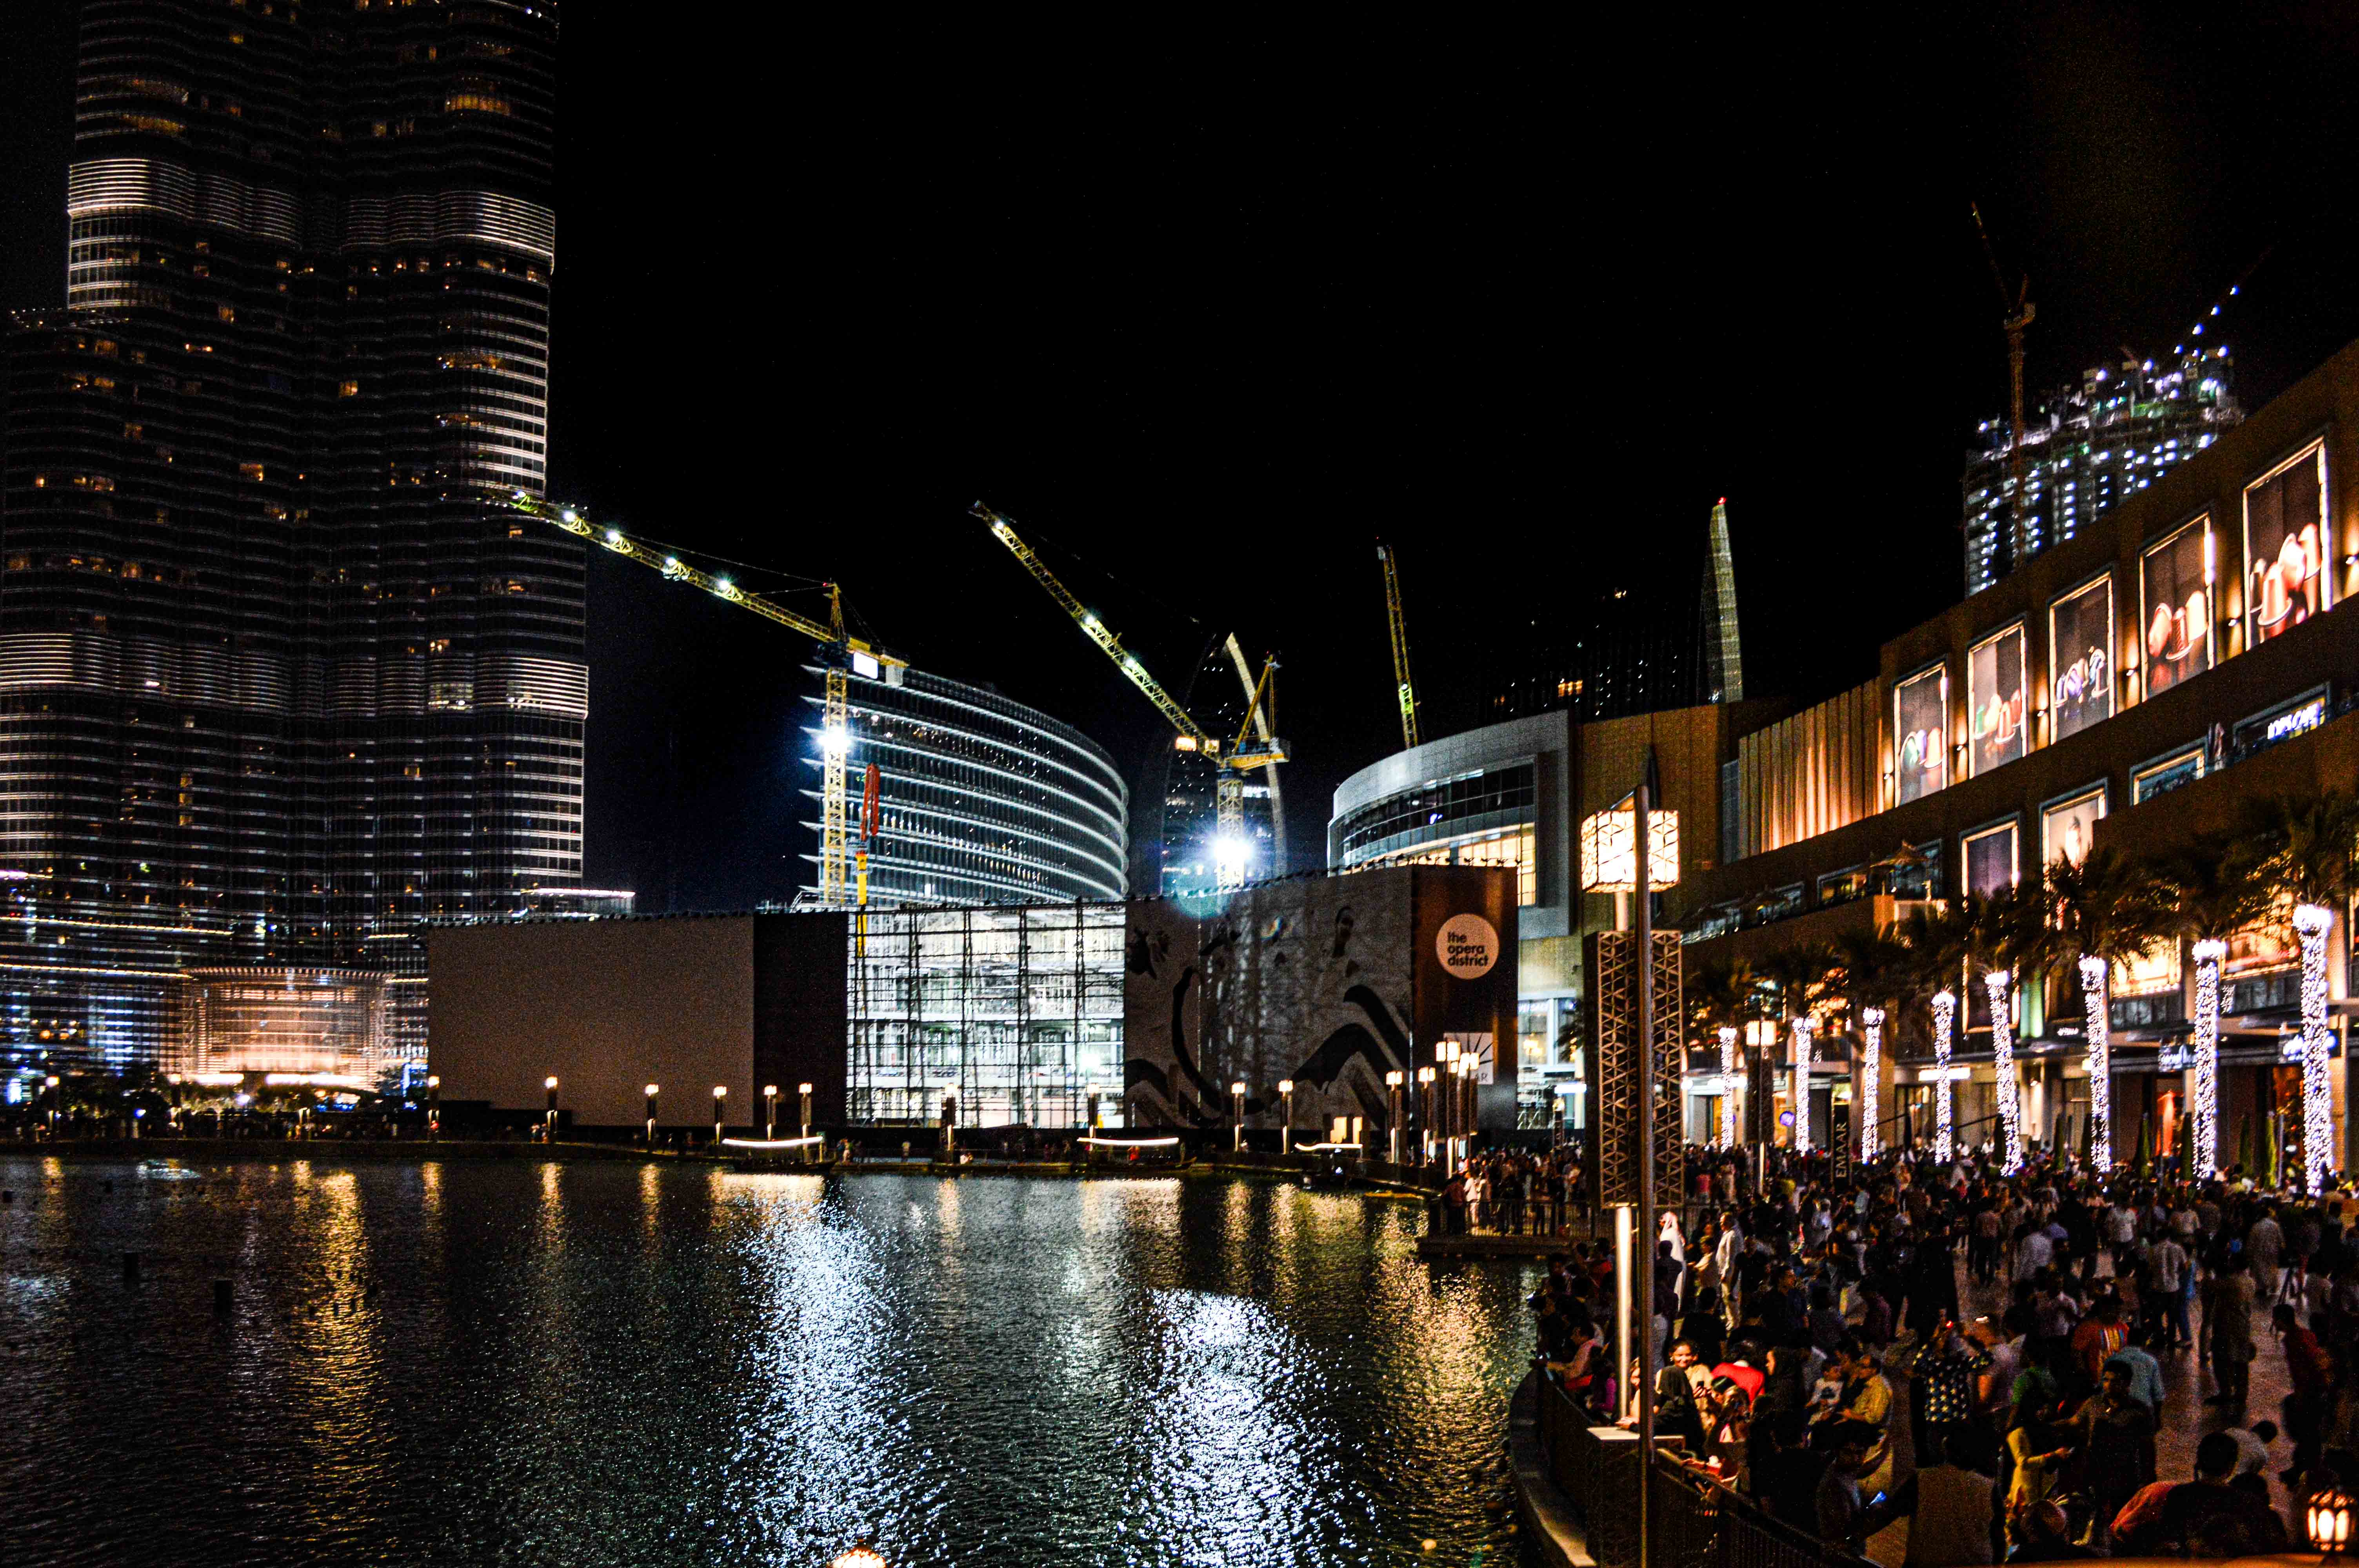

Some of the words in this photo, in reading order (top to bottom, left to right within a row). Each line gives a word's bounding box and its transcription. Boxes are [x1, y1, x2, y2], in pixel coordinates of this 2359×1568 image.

[1448, 931, 1467, 943] the
[1448, 945, 1485, 956] opera
[1448, 953, 1488, 966] district
[1836, 1122, 1847, 1178] EMAAR
